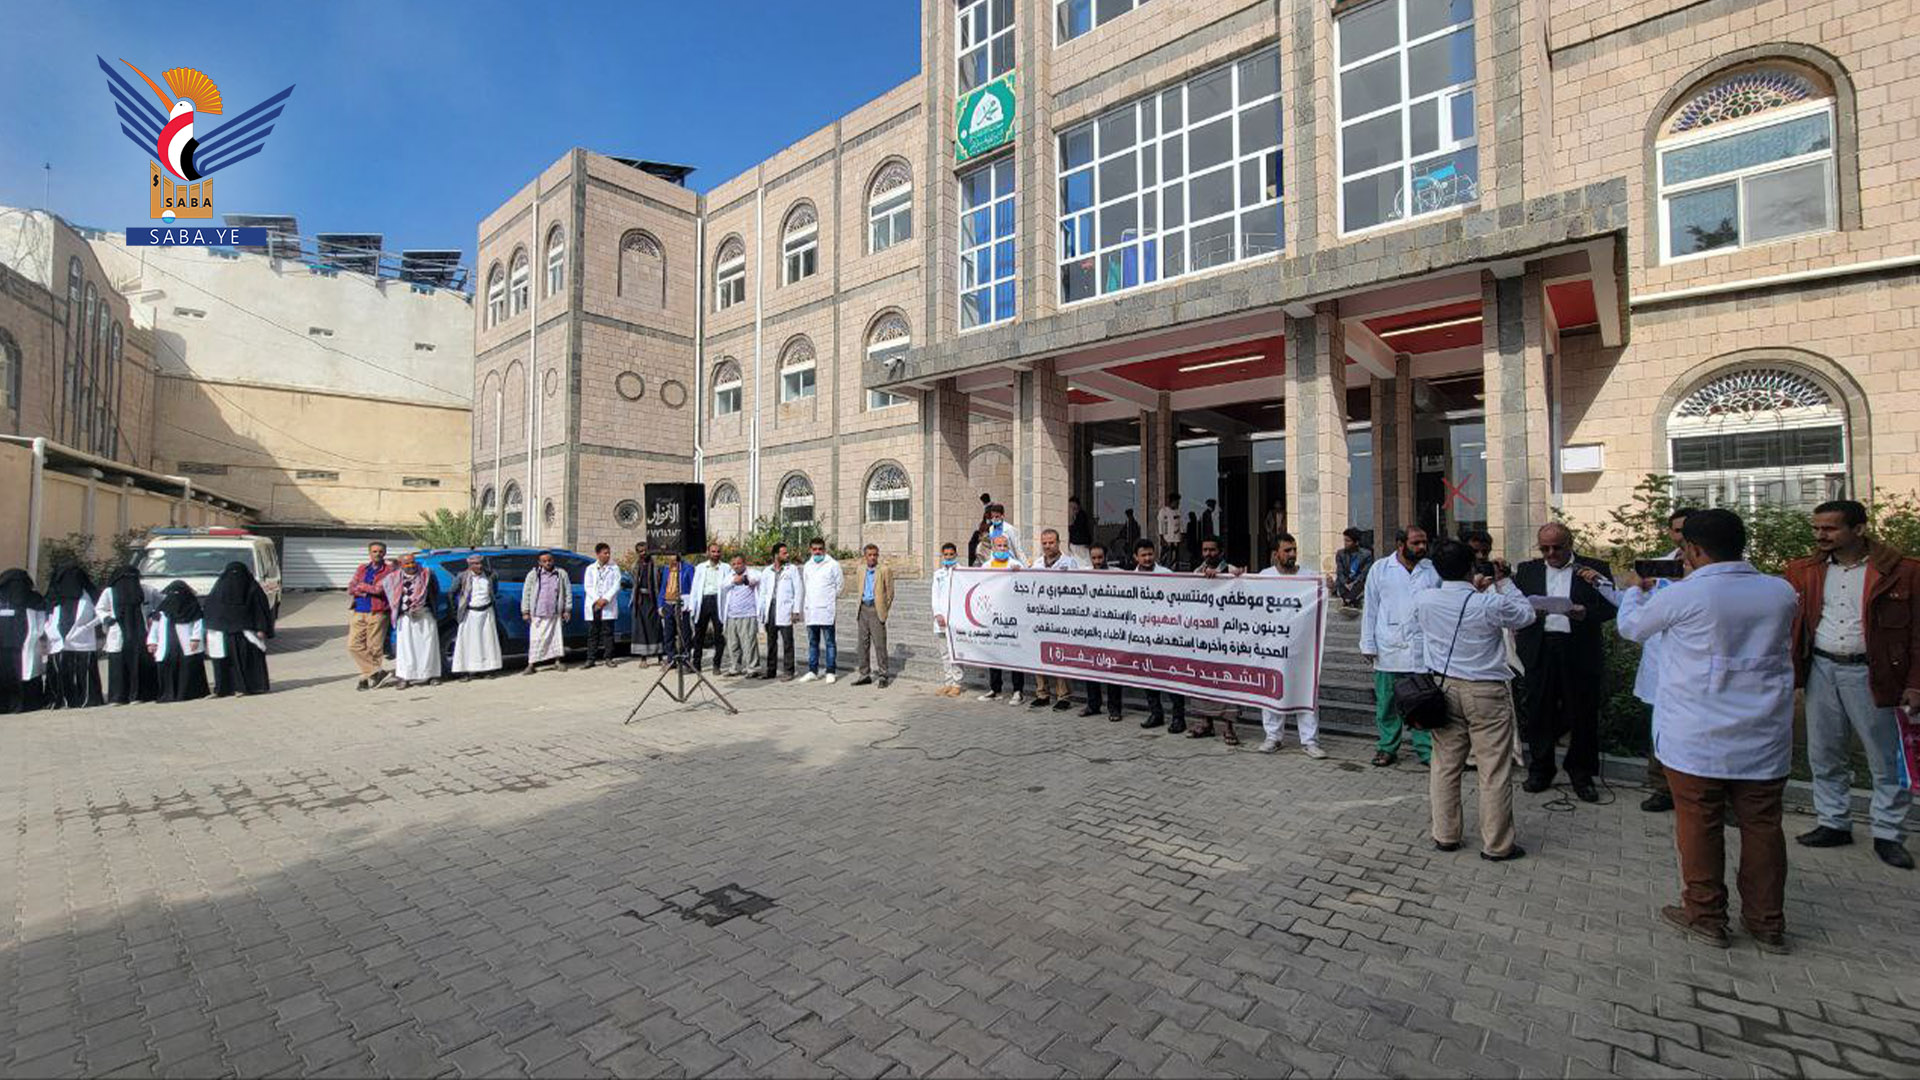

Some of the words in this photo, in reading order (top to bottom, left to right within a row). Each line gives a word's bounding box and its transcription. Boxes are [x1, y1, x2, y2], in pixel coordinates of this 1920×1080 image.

[1046, 582, 1087, 600] الجمهوري
[1089, 584, 1138, 600] المستشفى
[1140, 586, 1164, 605] هيئة
[1167, 589, 1214, 608] ومنتسبي
[1216, 590, 1264, 611] موظفي
[1265, 595, 1303, 613] جميع
[1026, 602, 1060, 617] للمنظومة
[1061, 605, 1090, 618] المتعمد
[1138, 612, 1182, 629] الصهيوني
[1183, 615, 1219, 630] العدوان
[1222, 618, 1250, 634] جرائم
[1033, 623, 1071, 638] بمستشفى
[1103, 627, 1126, 640] الأطباء
[1251, 622, 1290, 638] يدينون
[1128, 631, 1151, 647] وحصار
[1229, 642, 1252, 657] بغزة
[1253, 644, 1289, 659] الصحية
[1096, 653, 1139, 671] عدوان
